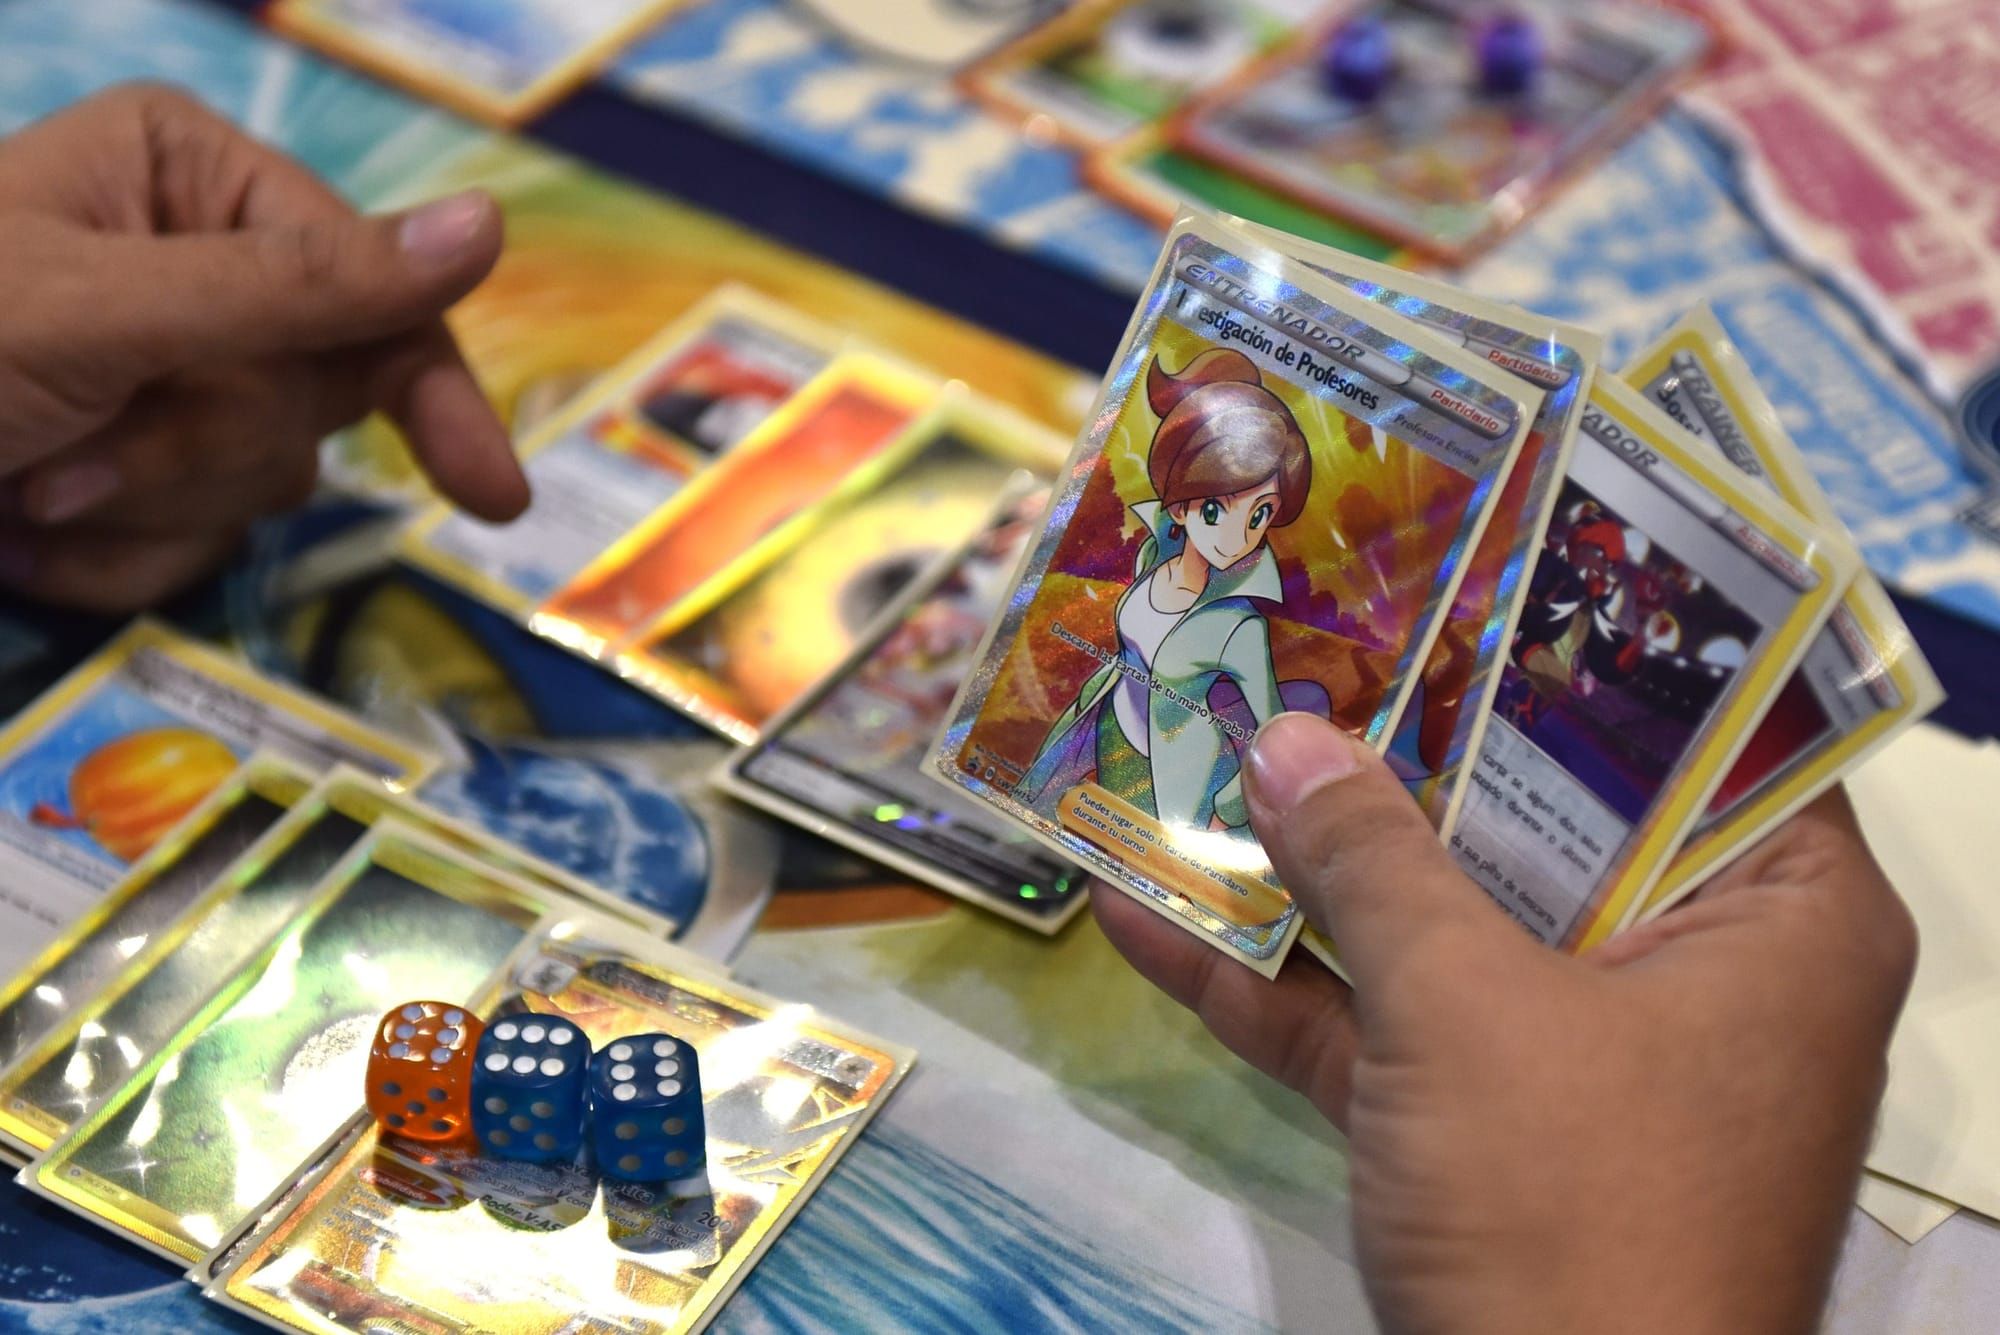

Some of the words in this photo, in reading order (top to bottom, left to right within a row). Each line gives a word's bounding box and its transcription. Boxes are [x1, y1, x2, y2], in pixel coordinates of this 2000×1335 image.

[1185, 264, 1366, 361] ENTRENADOR
[1176, 289, 1273, 355] Iestigación
[1275, 343, 1295, 366] de
[1296, 351, 1379, 410] Profesores
[1488, 349, 1561, 382] Partidario
[1431, 389, 1500, 433] Partidario
[1682, 354, 1763, 476] TRAINER
[1394, 414, 1444, 446] Profesora
[1445, 438, 1480, 466] Encina
[1583, 408, 1659, 468] ADOR
[1051, 623, 1097, 657] Descarta
[1099, 649, 1114, 665] las
[1114, 661, 1147, 683] cartas
[1150, 676, 1163, 693] de
[1165, 687, 1178, 700] tu
[1179, 694, 1208, 718] mano
[1219, 719, 1245, 739] roba
[1483, 754, 1507, 778] carta
[1072, 806, 1107, 831] durante
[1108, 827, 1119, 838] tu
[1120, 833, 1147, 856] turno.
[1507, 800, 1543, 834] durante
[1079, 791, 1110, 817] Puedes
[1111, 811, 1134, 831] jugar
[1135, 825, 1155, 843] solo
[1164, 843, 1188, 862] carta
[1190, 857, 1202, 869] de
[1202, 863, 1249, 898] Partidario
[480, 1194, 521, 1218] Poder
[697, 1211, 733, 1235] 200
